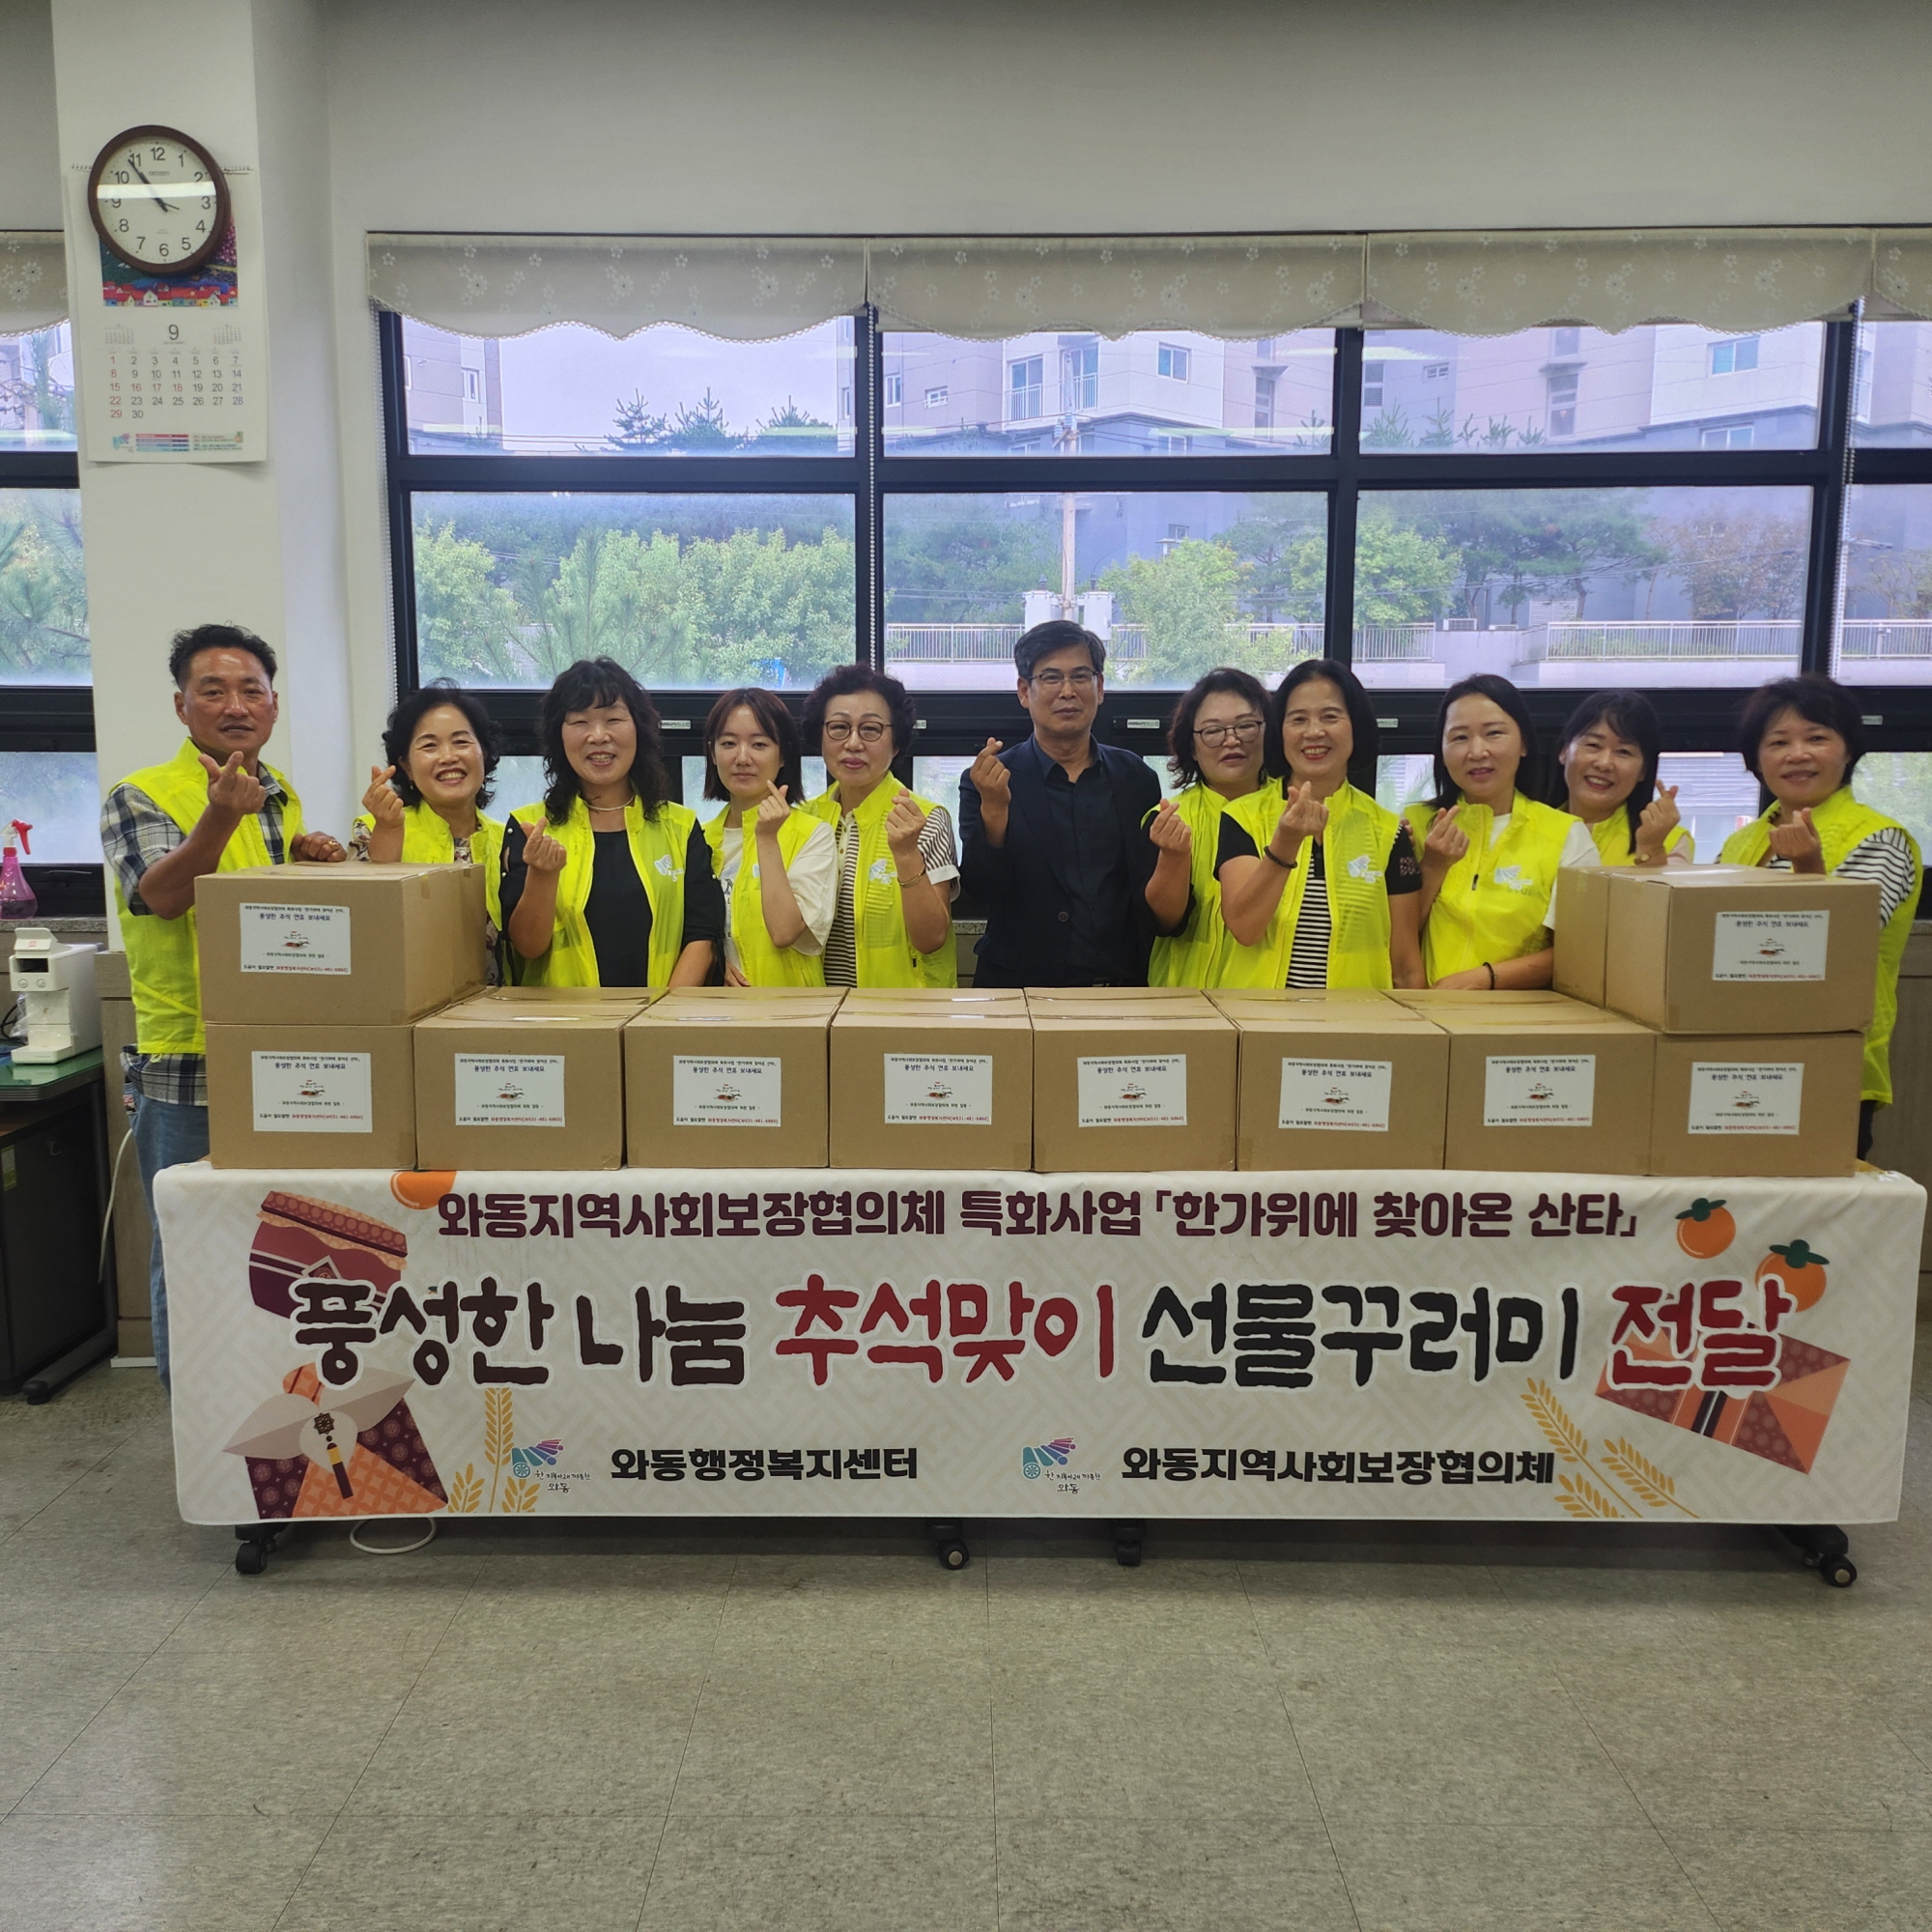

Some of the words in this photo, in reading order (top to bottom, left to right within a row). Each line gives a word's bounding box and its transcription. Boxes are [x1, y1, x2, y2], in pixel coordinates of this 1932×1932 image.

[151, 147, 165, 160] 12
[130, 155, 141, 166] 11
[179, 155, 184, 167] 1
[115, 172, 129, 184] 10
[194, 172, 203, 183] 2
[202, 196, 211, 209] 3
[119, 218, 128, 232] 8
[196, 219, 206, 233] 4
[136, 237, 146, 249] 7
[159, 243, 169, 256] 6
[182, 238, 191, 250] 5
[169, 325, 179, 340] 9
[110, 384, 120, 392] 15
[131, 384, 141, 392] 16
[153, 384, 161, 392] 17
[173, 384, 183, 392] 18
[193, 384, 203, 392] 19
[213, 384, 223, 392] 20
[232, 384, 242, 392] 21
[438, 1189, 945, 1240] 와동지역사회보장협의체
[960, 1188, 1143, 1238] 특화사업
[1156, 1189, 1357, 1240] 「한가위에
[1372, 1189, 1513, 1240] 찾아온
[1529, 1189, 1636, 1240] 산타」
[293, 1276, 554, 1386] 풍성한
[577, 1284, 746, 1388] 나눔
[775, 1273, 1114, 1385] 추석맞이
[1143, 1283, 1577, 1388] 선물꾸러미
[1609, 1278, 1789, 1389] 전달
[610, 1447, 918, 1482] 와동행정복지센터
[1122, 1447, 1553, 1485] 와동지역사회보장협의체
[548, 1483, 570, 1493] 와동
[1057, 1484, 1080, 1494] 와동
